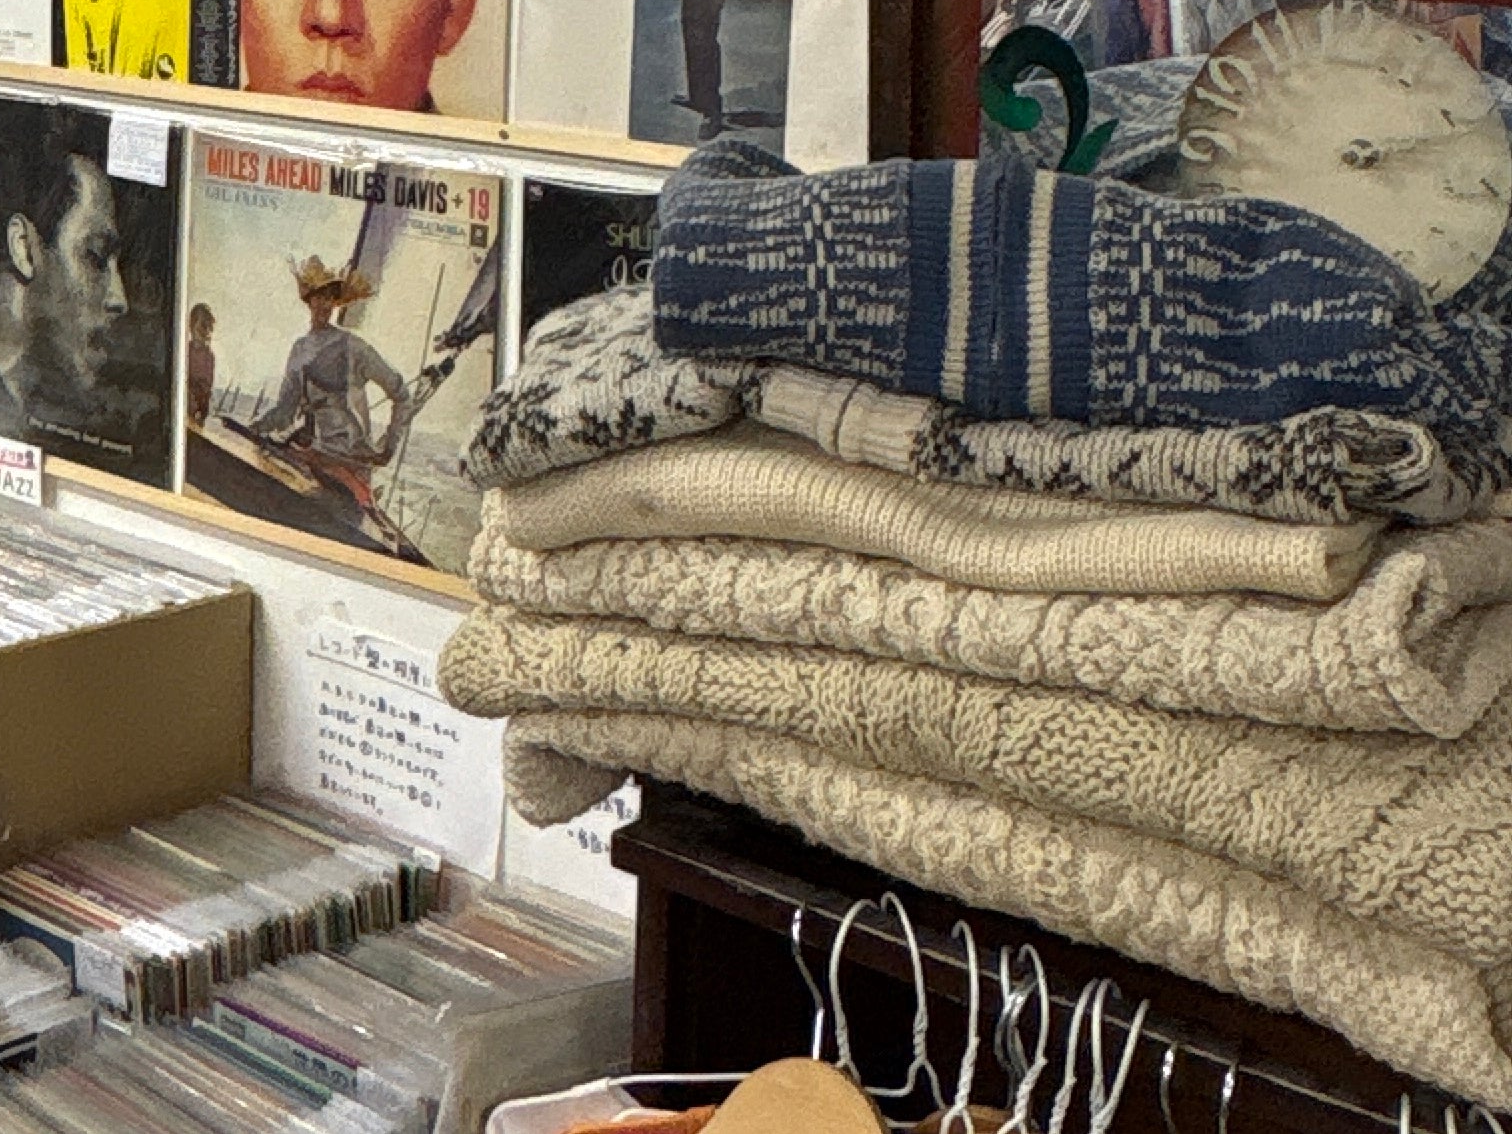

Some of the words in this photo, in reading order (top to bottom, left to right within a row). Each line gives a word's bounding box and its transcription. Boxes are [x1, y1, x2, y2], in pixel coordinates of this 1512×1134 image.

[206, 145, 258, 184] MILES
[265, 153, 322, 194] AHEAD
[328, 164, 387, 205] MILES
[393, 175, 447, 213] DAVIS
[467, 186, 490, 222] 19
